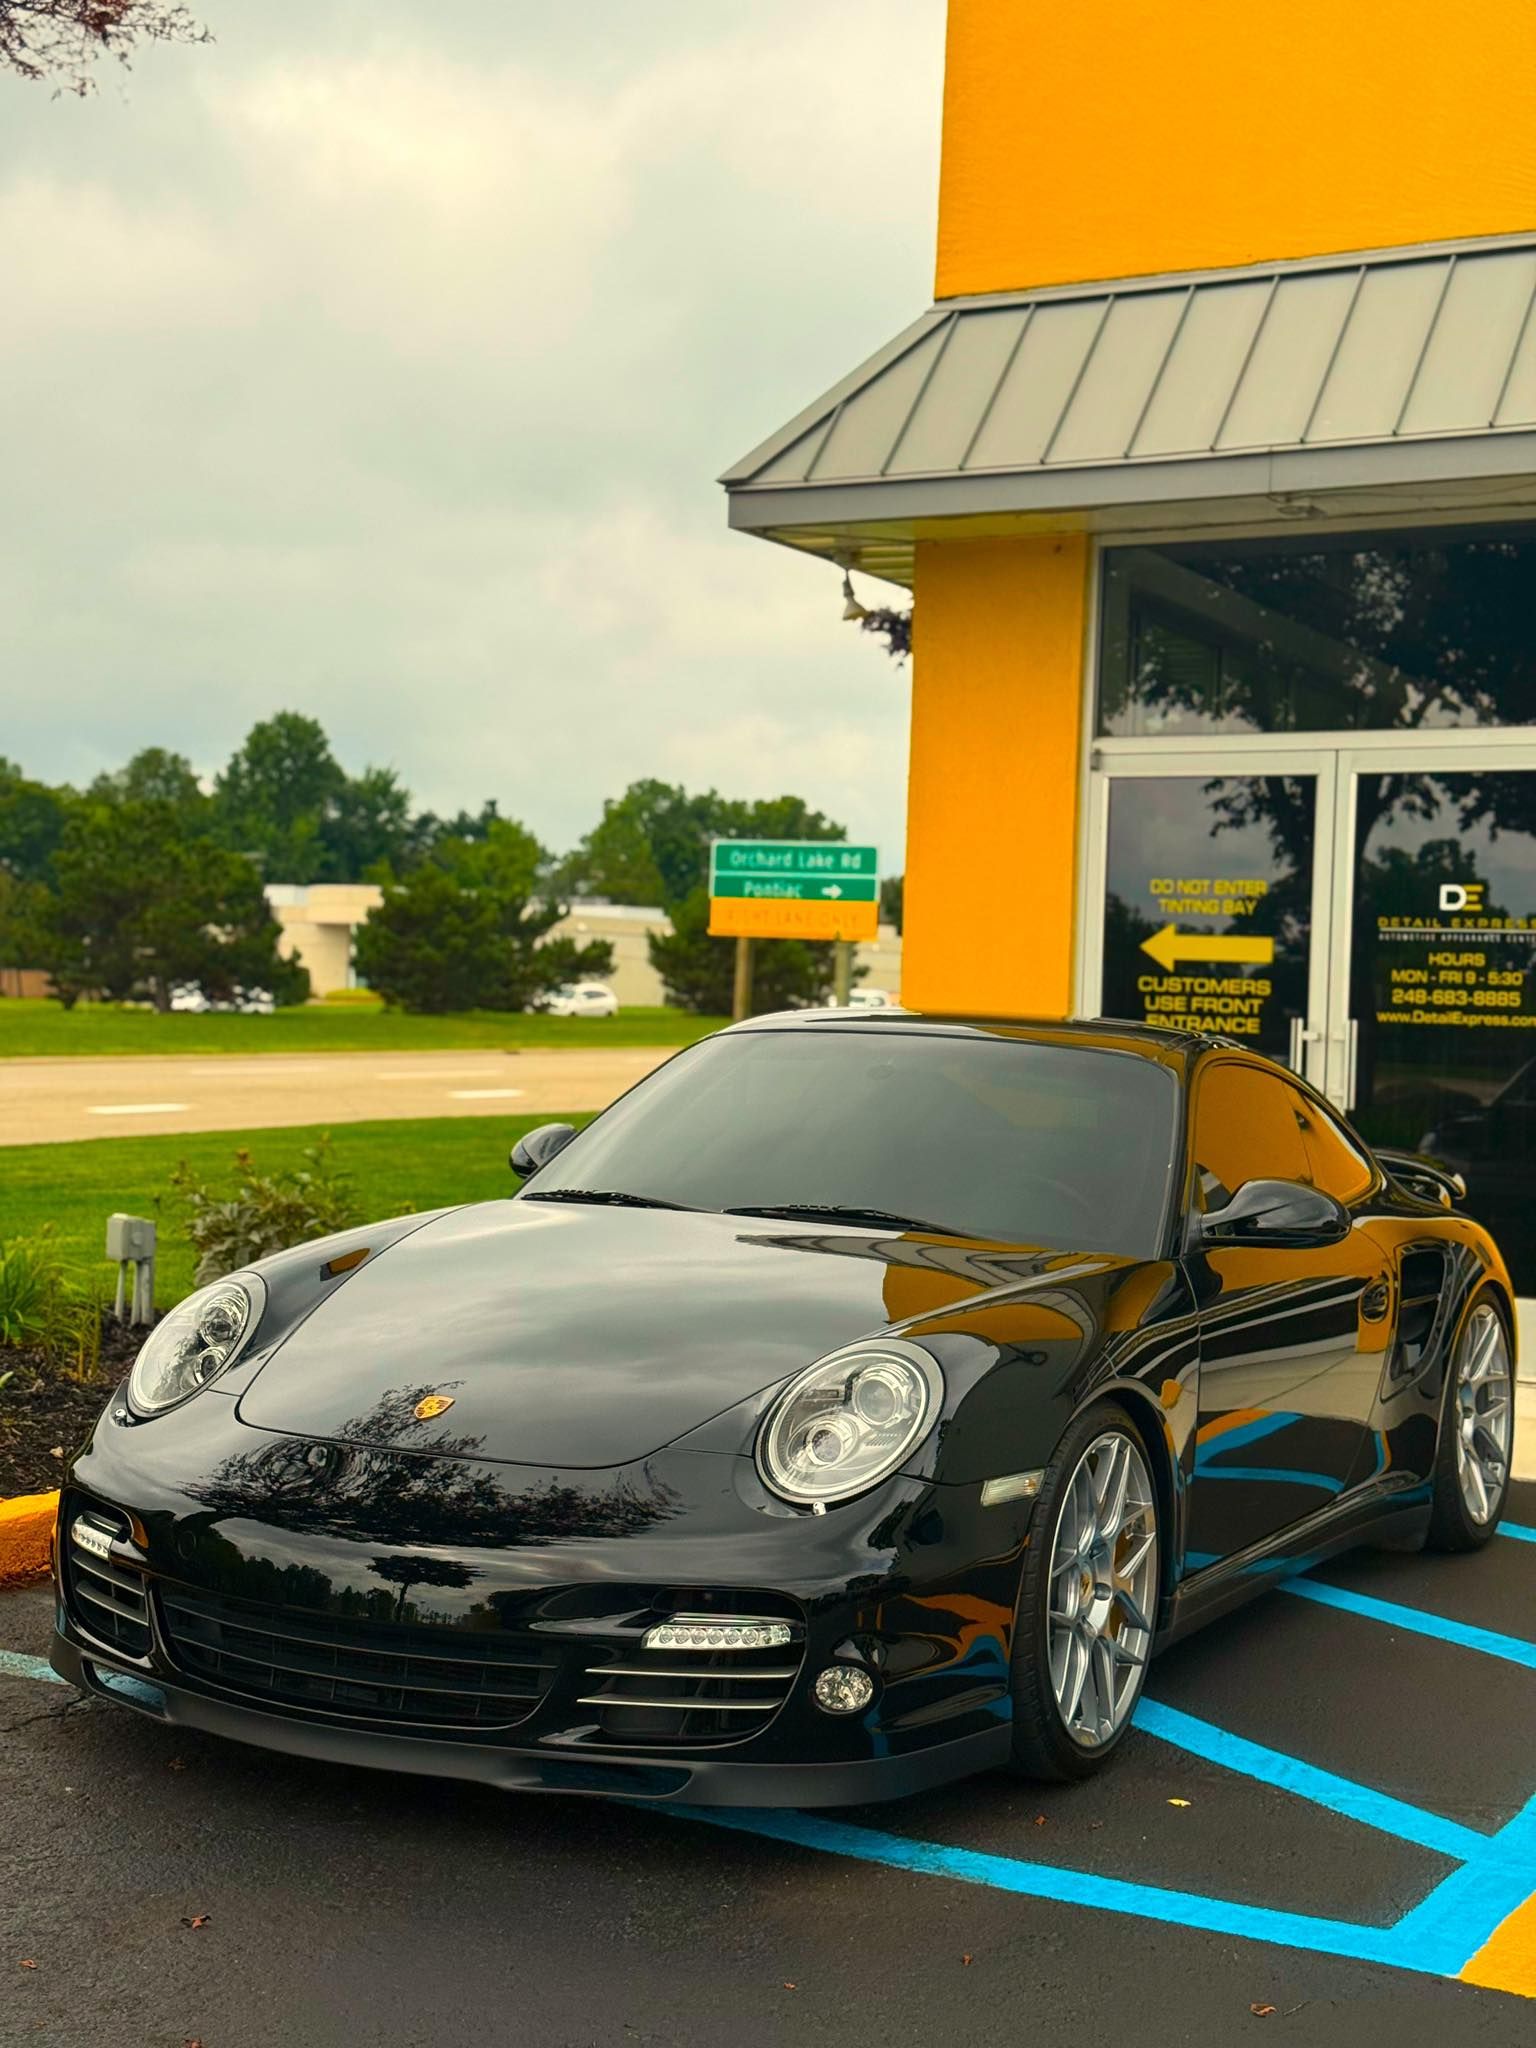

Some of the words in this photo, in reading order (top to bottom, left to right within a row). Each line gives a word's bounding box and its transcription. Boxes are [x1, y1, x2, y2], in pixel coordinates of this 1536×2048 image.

[730, 850, 793, 867] Orchard
[799, 851, 835, 869] Lake
[841, 853, 862, 870] Rd
[744, 881, 803, 898] Pontiac
[1150, 879, 1175, 894] DO
[1177, 879, 1210, 895] NOT
[1214, 879, 1269, 896] ENTER
[1439, 883, 1483, 911] DE
[1159, 898, 1220, 915] TINTING
[1223, 899, 1259, 916] BAY
[1377, 917, 1441, 928] DETAIL
[1428, 952, 1486, 967] HOURS
[1137, 975, 1272, 996] CUSTOMERS
[1391, 969, 1428, 984] MON
[1439, 970, 1463, 984] FRI
[1465, 971, 1477, 985] 9
[1487, 971, 1524, 986] 5:30
[1144, 995, 1187, 1012] USE
[1191, 996, 1264, 1015] FRONT
[1146, 1013, 1261, 1034] ENTRANCE
